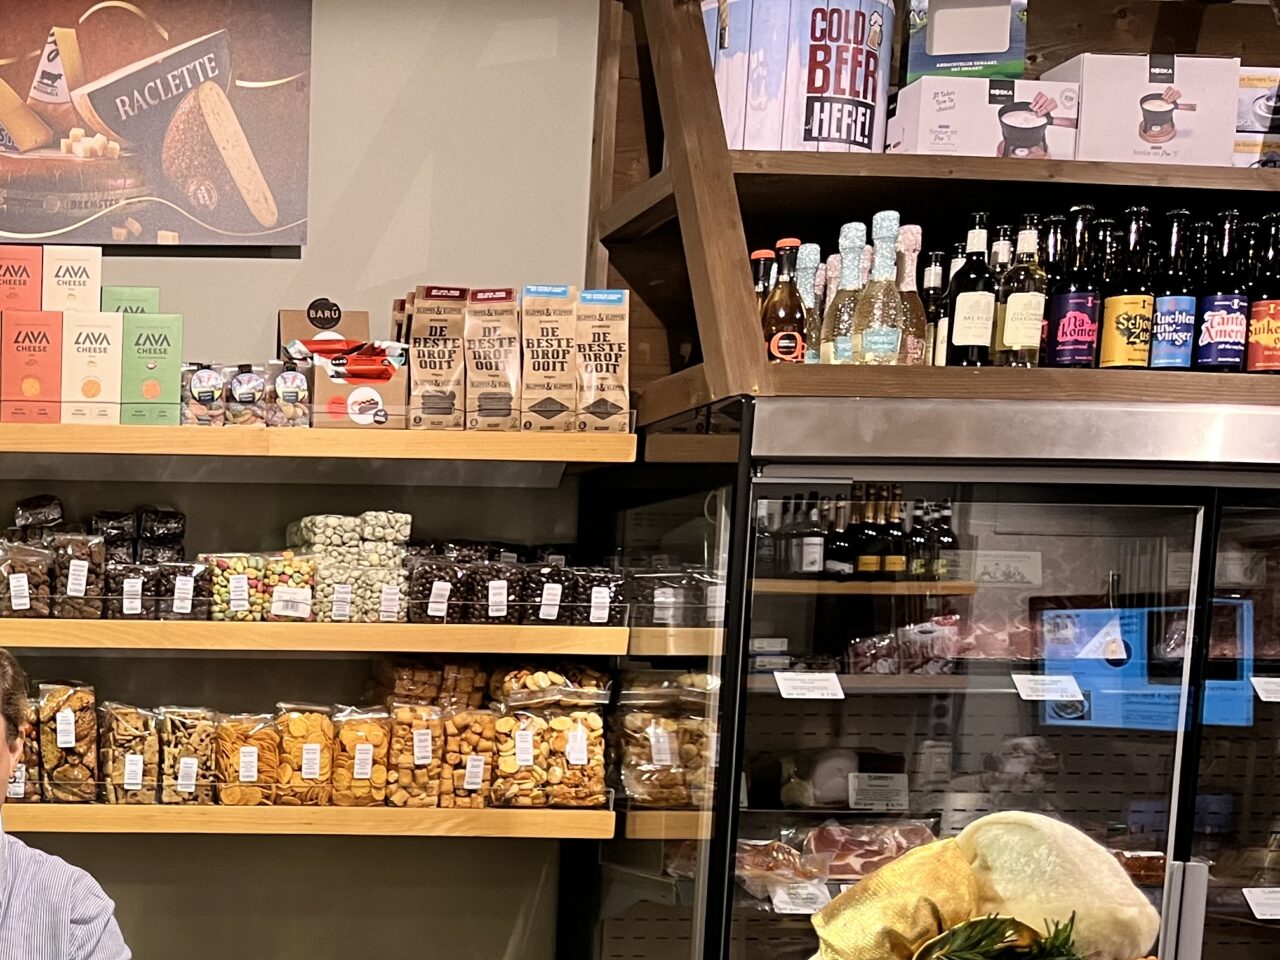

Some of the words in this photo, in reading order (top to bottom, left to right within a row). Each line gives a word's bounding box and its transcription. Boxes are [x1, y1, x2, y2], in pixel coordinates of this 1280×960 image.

[810, 7, 866, 45] COLD
[807, 44, 879, 101] BEER
[115, 52, 219, 120] RACLETTE
[812, 102, 871, 143] HERE!
[54, 265, 90, 279] LAVA
[56, 279, 87, 287] CHEESE
[309, 306, 339, 318] BARÚ
[428, 326, 447, 337] DE
[540, 327, 559, 337] DE
[1061, 325, 1095, 338] komer
[13, 331, 50, 345] LAVA
[73, 332, 111, 346] LAVA
[133, 333, 171, 347] LAVA
[413, 338, 460, 348] BESTE
[592, 332, 611, 343] DE
[1157, 331, 1191, 346] vinger
[16, 345, 48, 353] CHEESE
[467, 337, 516, 350] BESTE
[525, 338, 574, 349] BESTE
[577, 343, 626, 353] BESTE
[76, 346, 108, 354] CHEESE
[136, 347, 168, 355] CHEESE
[417, 350, 456, 360] DROP
[530, 349, 570, 360] DROP
[583, 352, 623, 363] DROP
[420, 359, 454, 370] OOIT
[532, 360, 567, 371] OOIT
